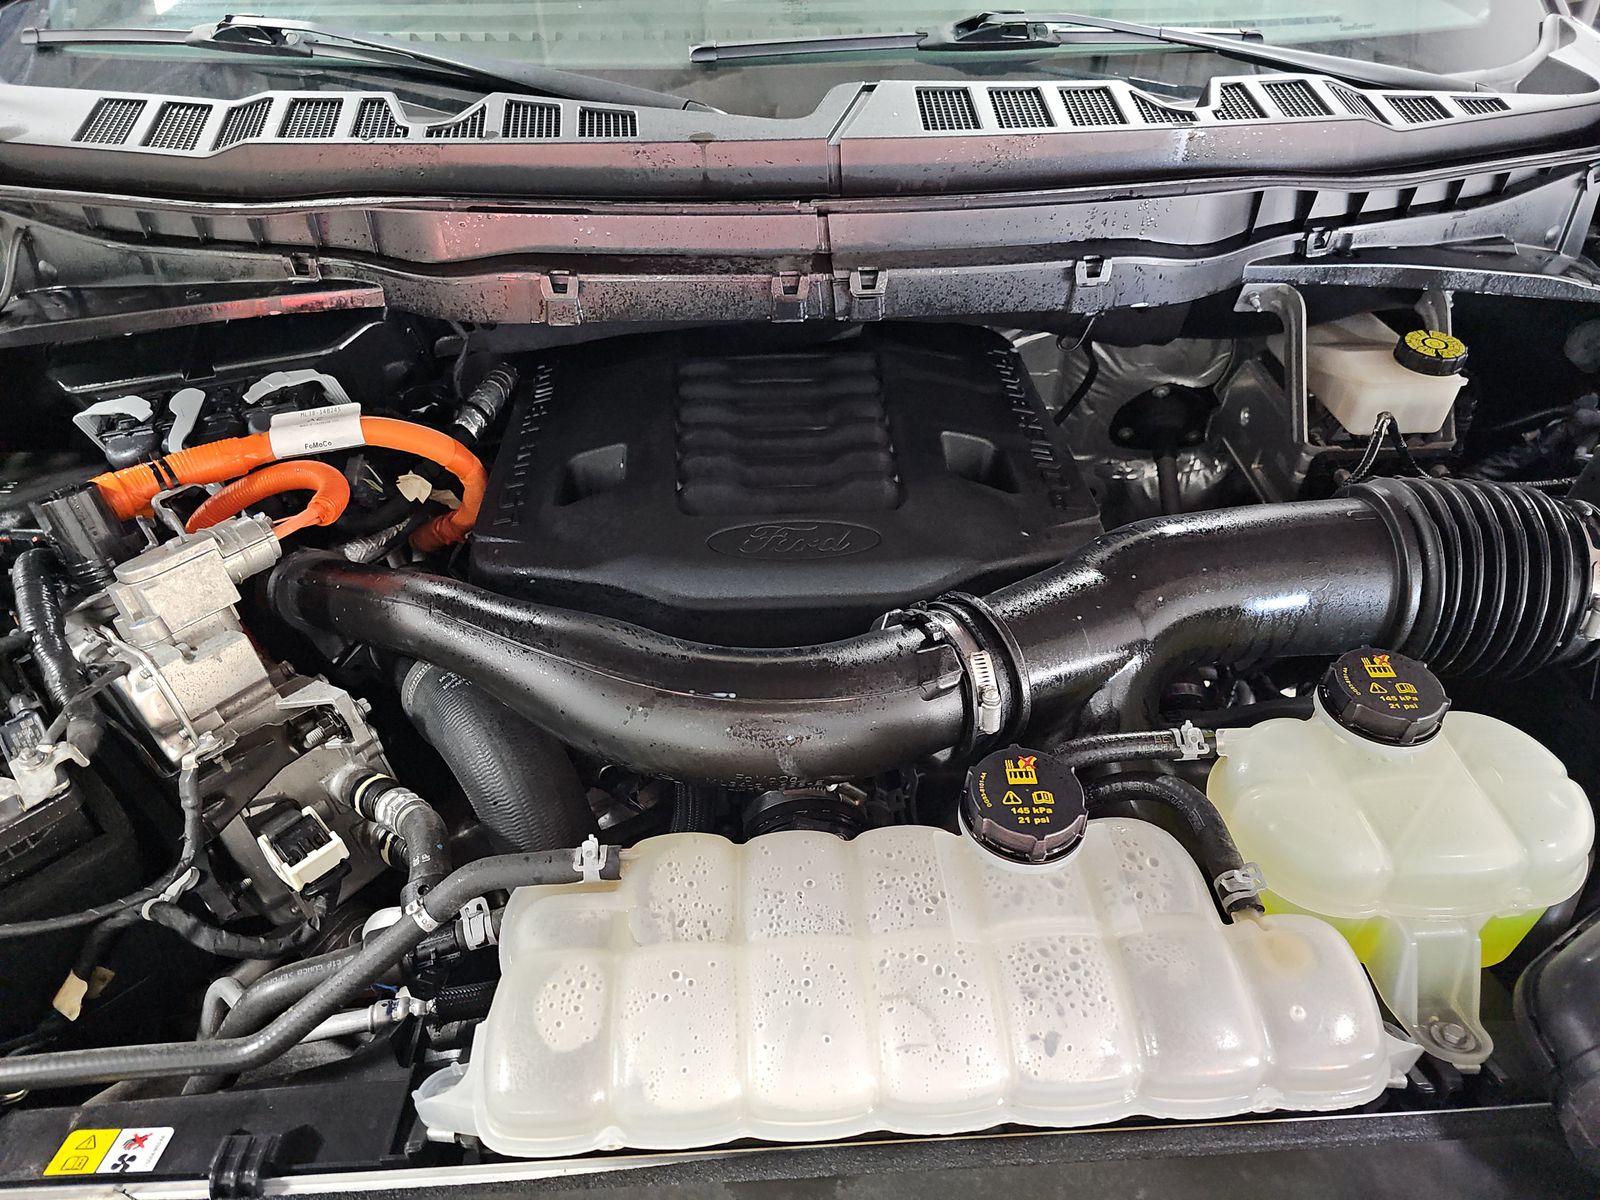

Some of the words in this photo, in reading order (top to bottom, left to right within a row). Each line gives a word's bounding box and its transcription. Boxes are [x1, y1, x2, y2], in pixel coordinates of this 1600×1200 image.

[304, 440, 332, 450] FoMoCo
[739, 525, 852, 553] Ford
[1032, 806, 1053, 814] kPa
[1018, 816, 1031, 824] 21
[1034, 816, 1050, 825] psi
